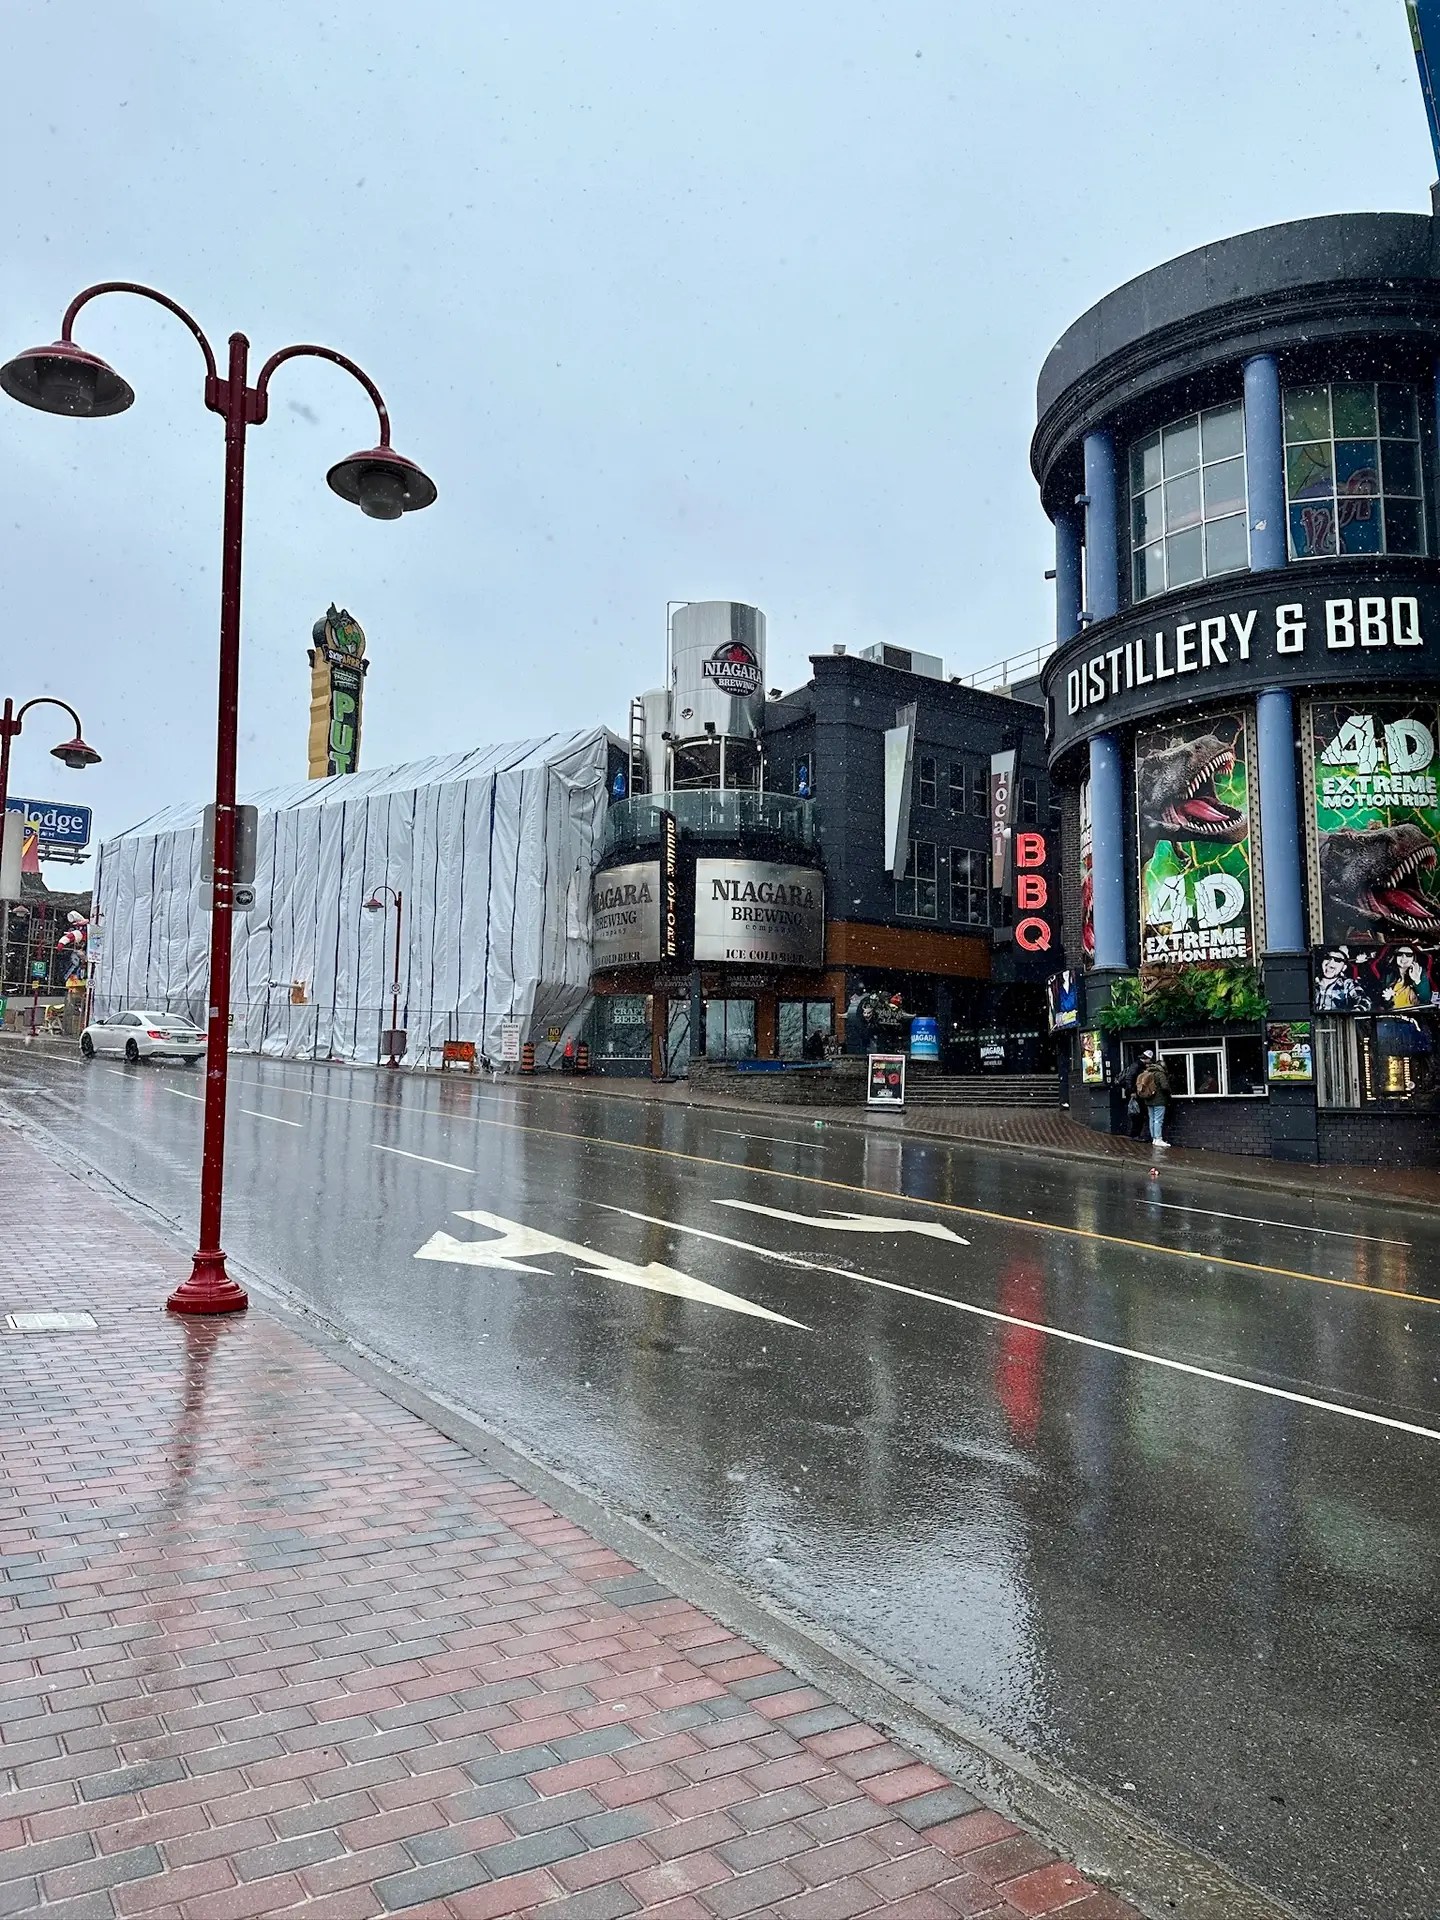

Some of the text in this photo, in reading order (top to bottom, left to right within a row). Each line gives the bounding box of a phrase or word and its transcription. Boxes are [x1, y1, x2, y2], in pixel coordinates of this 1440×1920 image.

[1067, 596, 1423, 716] DISTILLERY & BBQ
[704, 662, 762, 684] NIAGARA
[718, 678, 755, 691] BREWING
[1320, 714, 1435, 776] 4D
[1322, 774, 1437, 796] EXTREME
[1322, 793, 1438, 811] MOTION RIDE
[666, 818, 676, 957] BEER STORE
[711, 879, 815, 910] NIAGARA
[1015, 833, 1051, 951] BBQ
[1146, 872, 1246, 932] 4D
[731, 906, 802, 926] BREWING
[1146, 927, 1247, 955] EXTREME
[618, 951, 640, 963] BEER
[726, 949, 746, 959] ICE
[749, 950, 779, 961] COLD
[1147, 944, 1247, 964] MOTION RIDE
[613, 1015, 645, 1024] BEER
[549, 1028, 560, 1036] NO
[910, 1034, 937, 1044] NIAGARA
[980, 1046, 1005, 1058] NIAGARA
